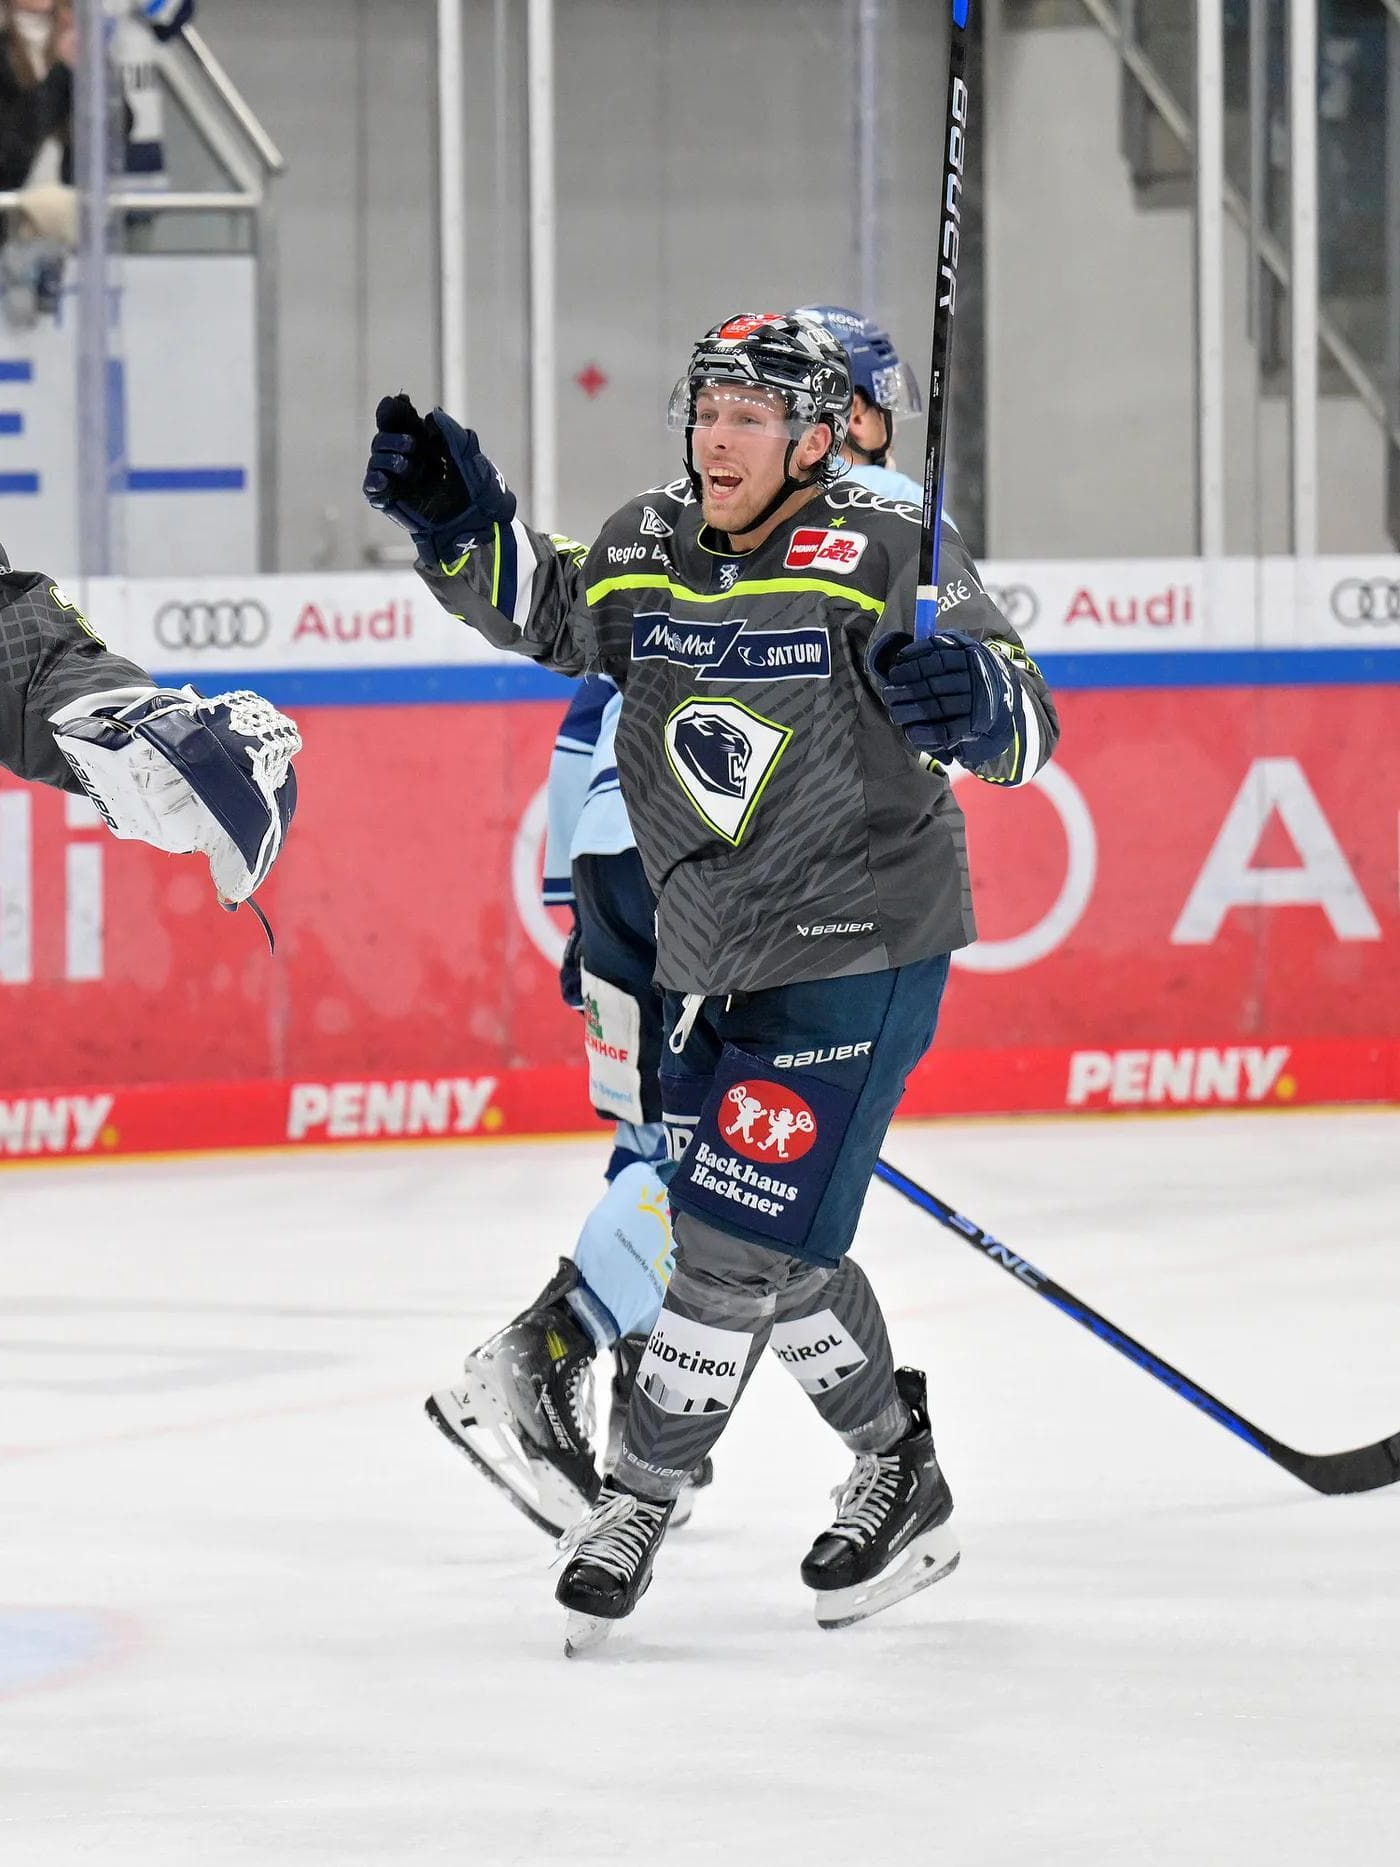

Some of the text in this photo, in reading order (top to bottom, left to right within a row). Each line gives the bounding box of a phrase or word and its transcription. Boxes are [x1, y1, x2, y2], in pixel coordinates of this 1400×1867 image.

[940, 76, 968, 316] BAUER
[607, 542, 647, 564] Regio
[292, 601, 415, 641] Audi
[1064, 587, 1194, 626] Audi
[812, 919, 874, 937] BAUER
[773, 1041, 872, 1068] BAUER
[689, 1164, 785, 1217] Hackner
[695, 1142, 799, 1201] Backhaus
[948, 1213, 1048, 1287] SYNC
[627, 1452, 684, 1478] BAUER
